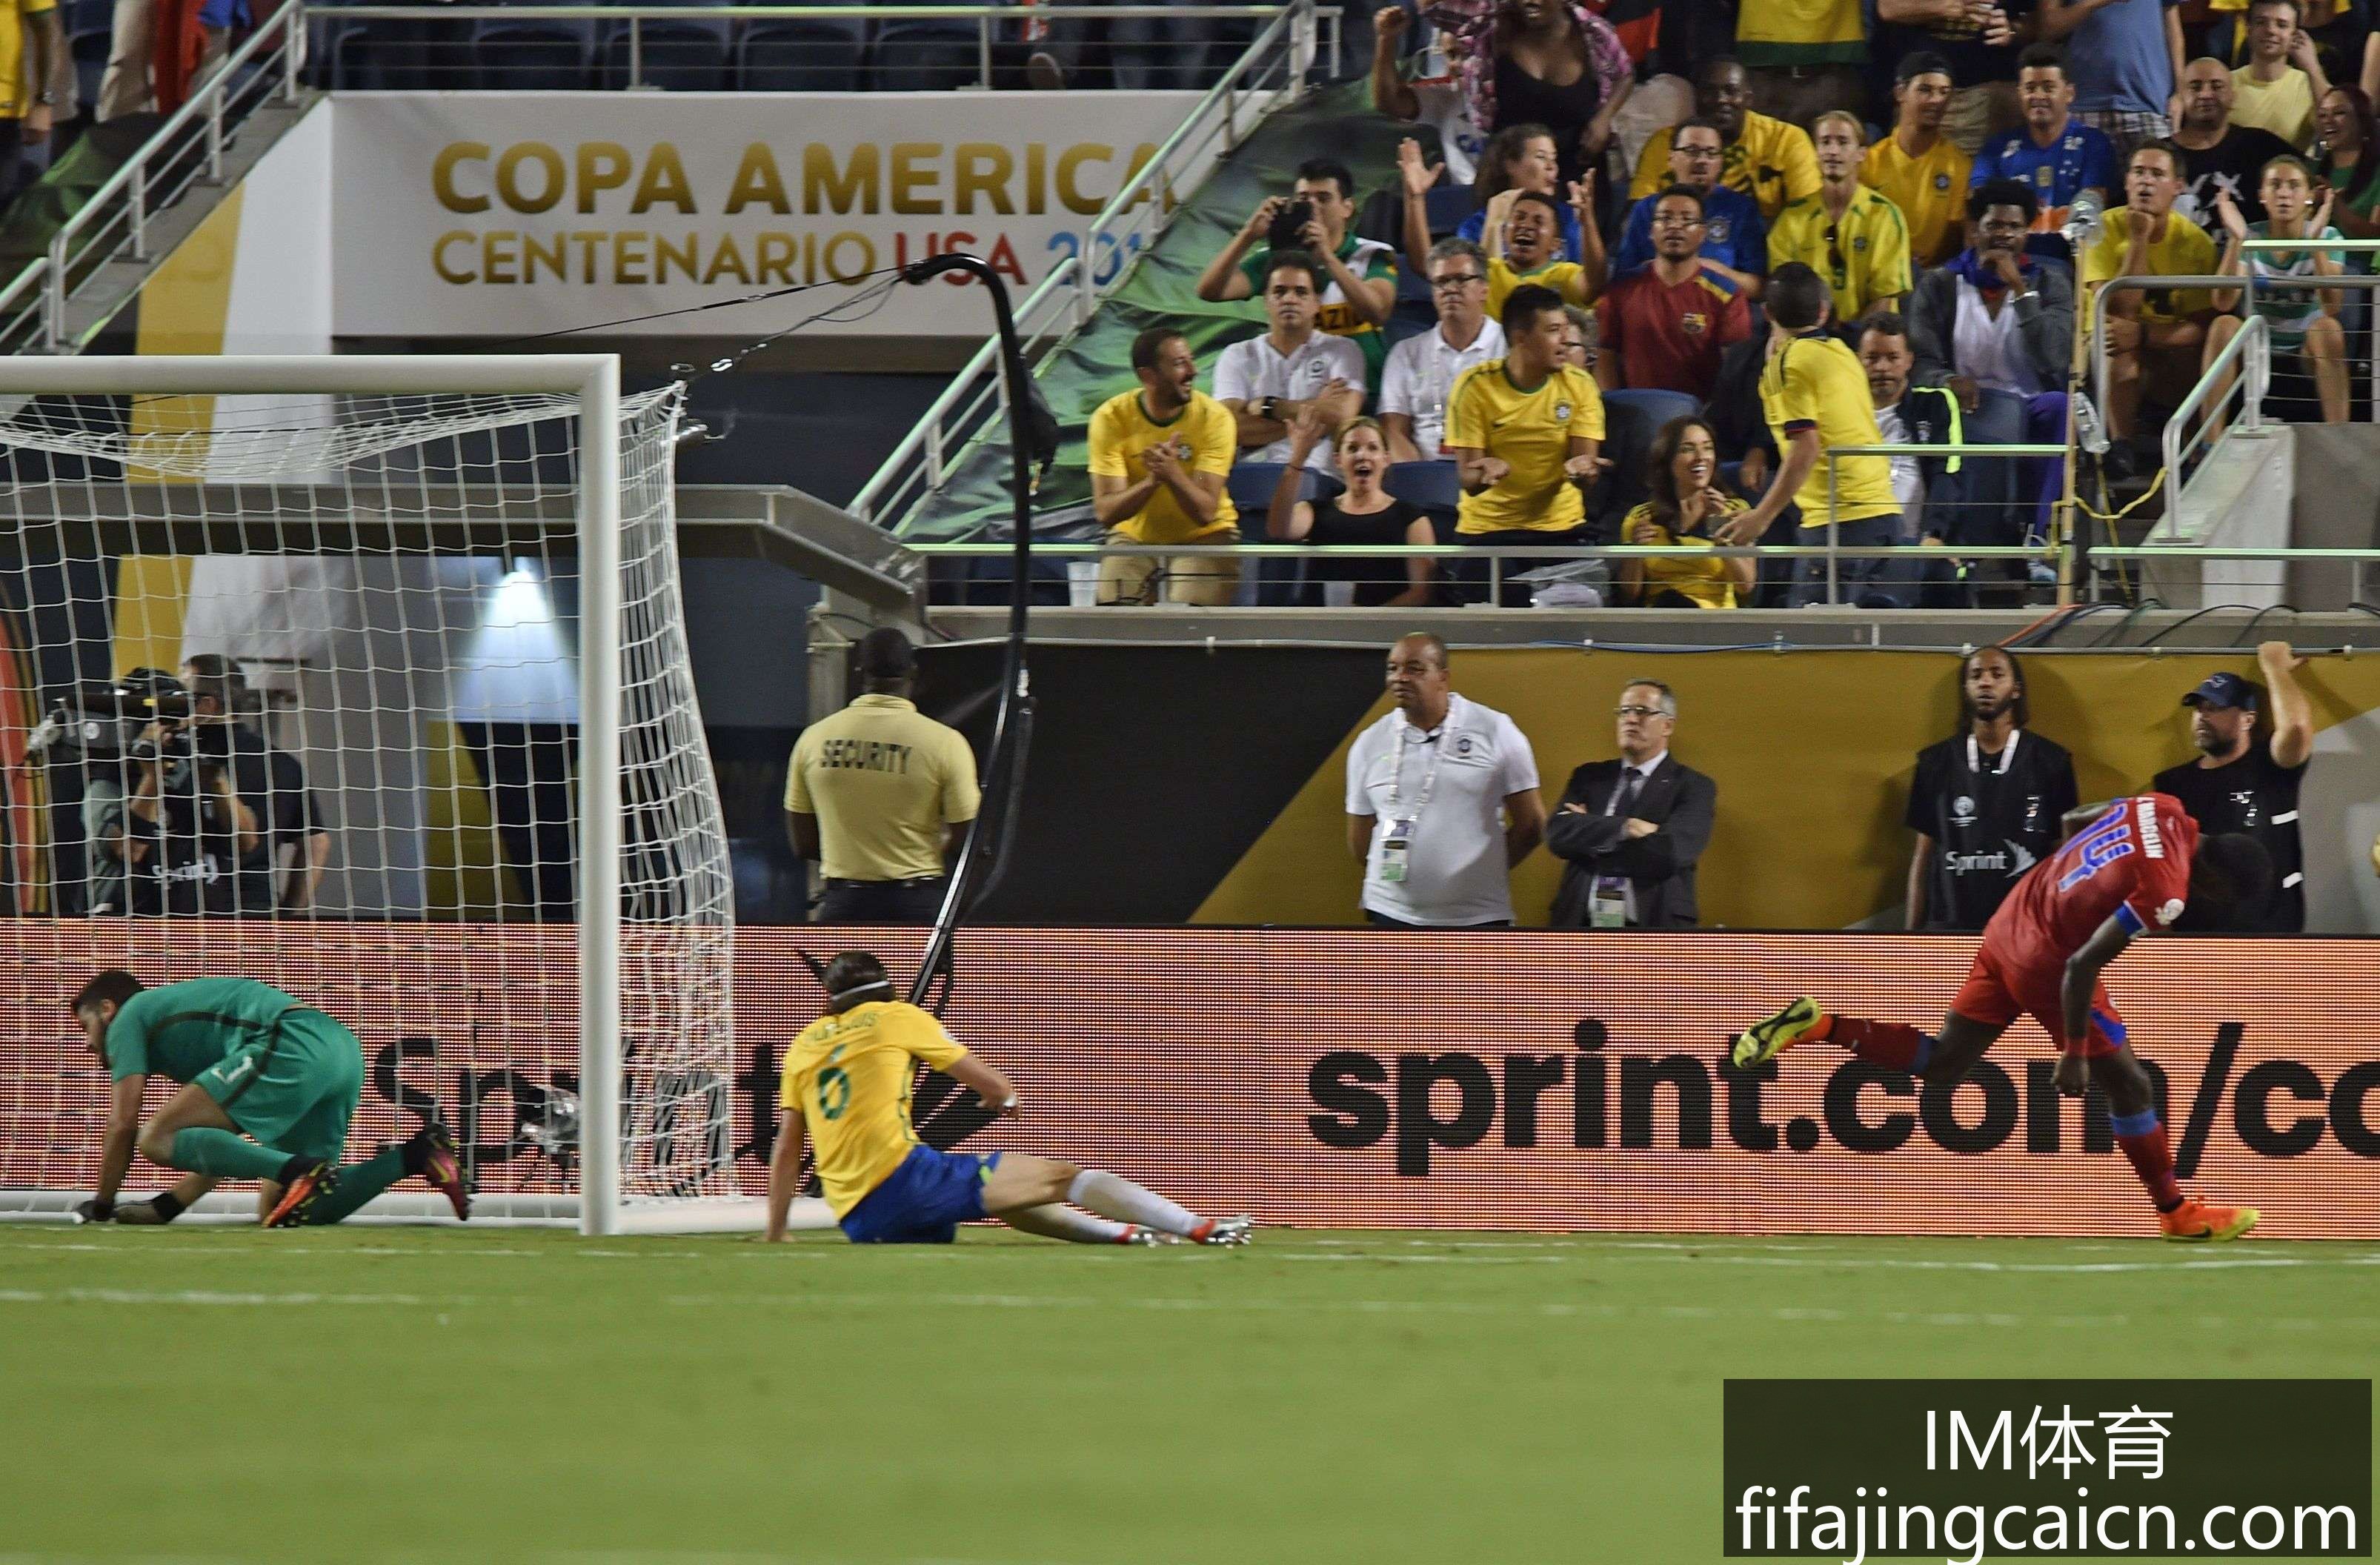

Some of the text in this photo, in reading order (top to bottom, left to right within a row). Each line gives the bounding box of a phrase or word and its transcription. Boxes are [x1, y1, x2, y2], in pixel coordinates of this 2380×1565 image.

[432, 141, 1177, 215] COPA AMERICA
[432, 230, 876, 285] CENTENARIO
[894, 230, 1028, 285] USA
[820, 740, 912, 774] SECURITY
[1945, 851, 2007, 876] Sprint
[818, 1043, 851, 1120] 6
